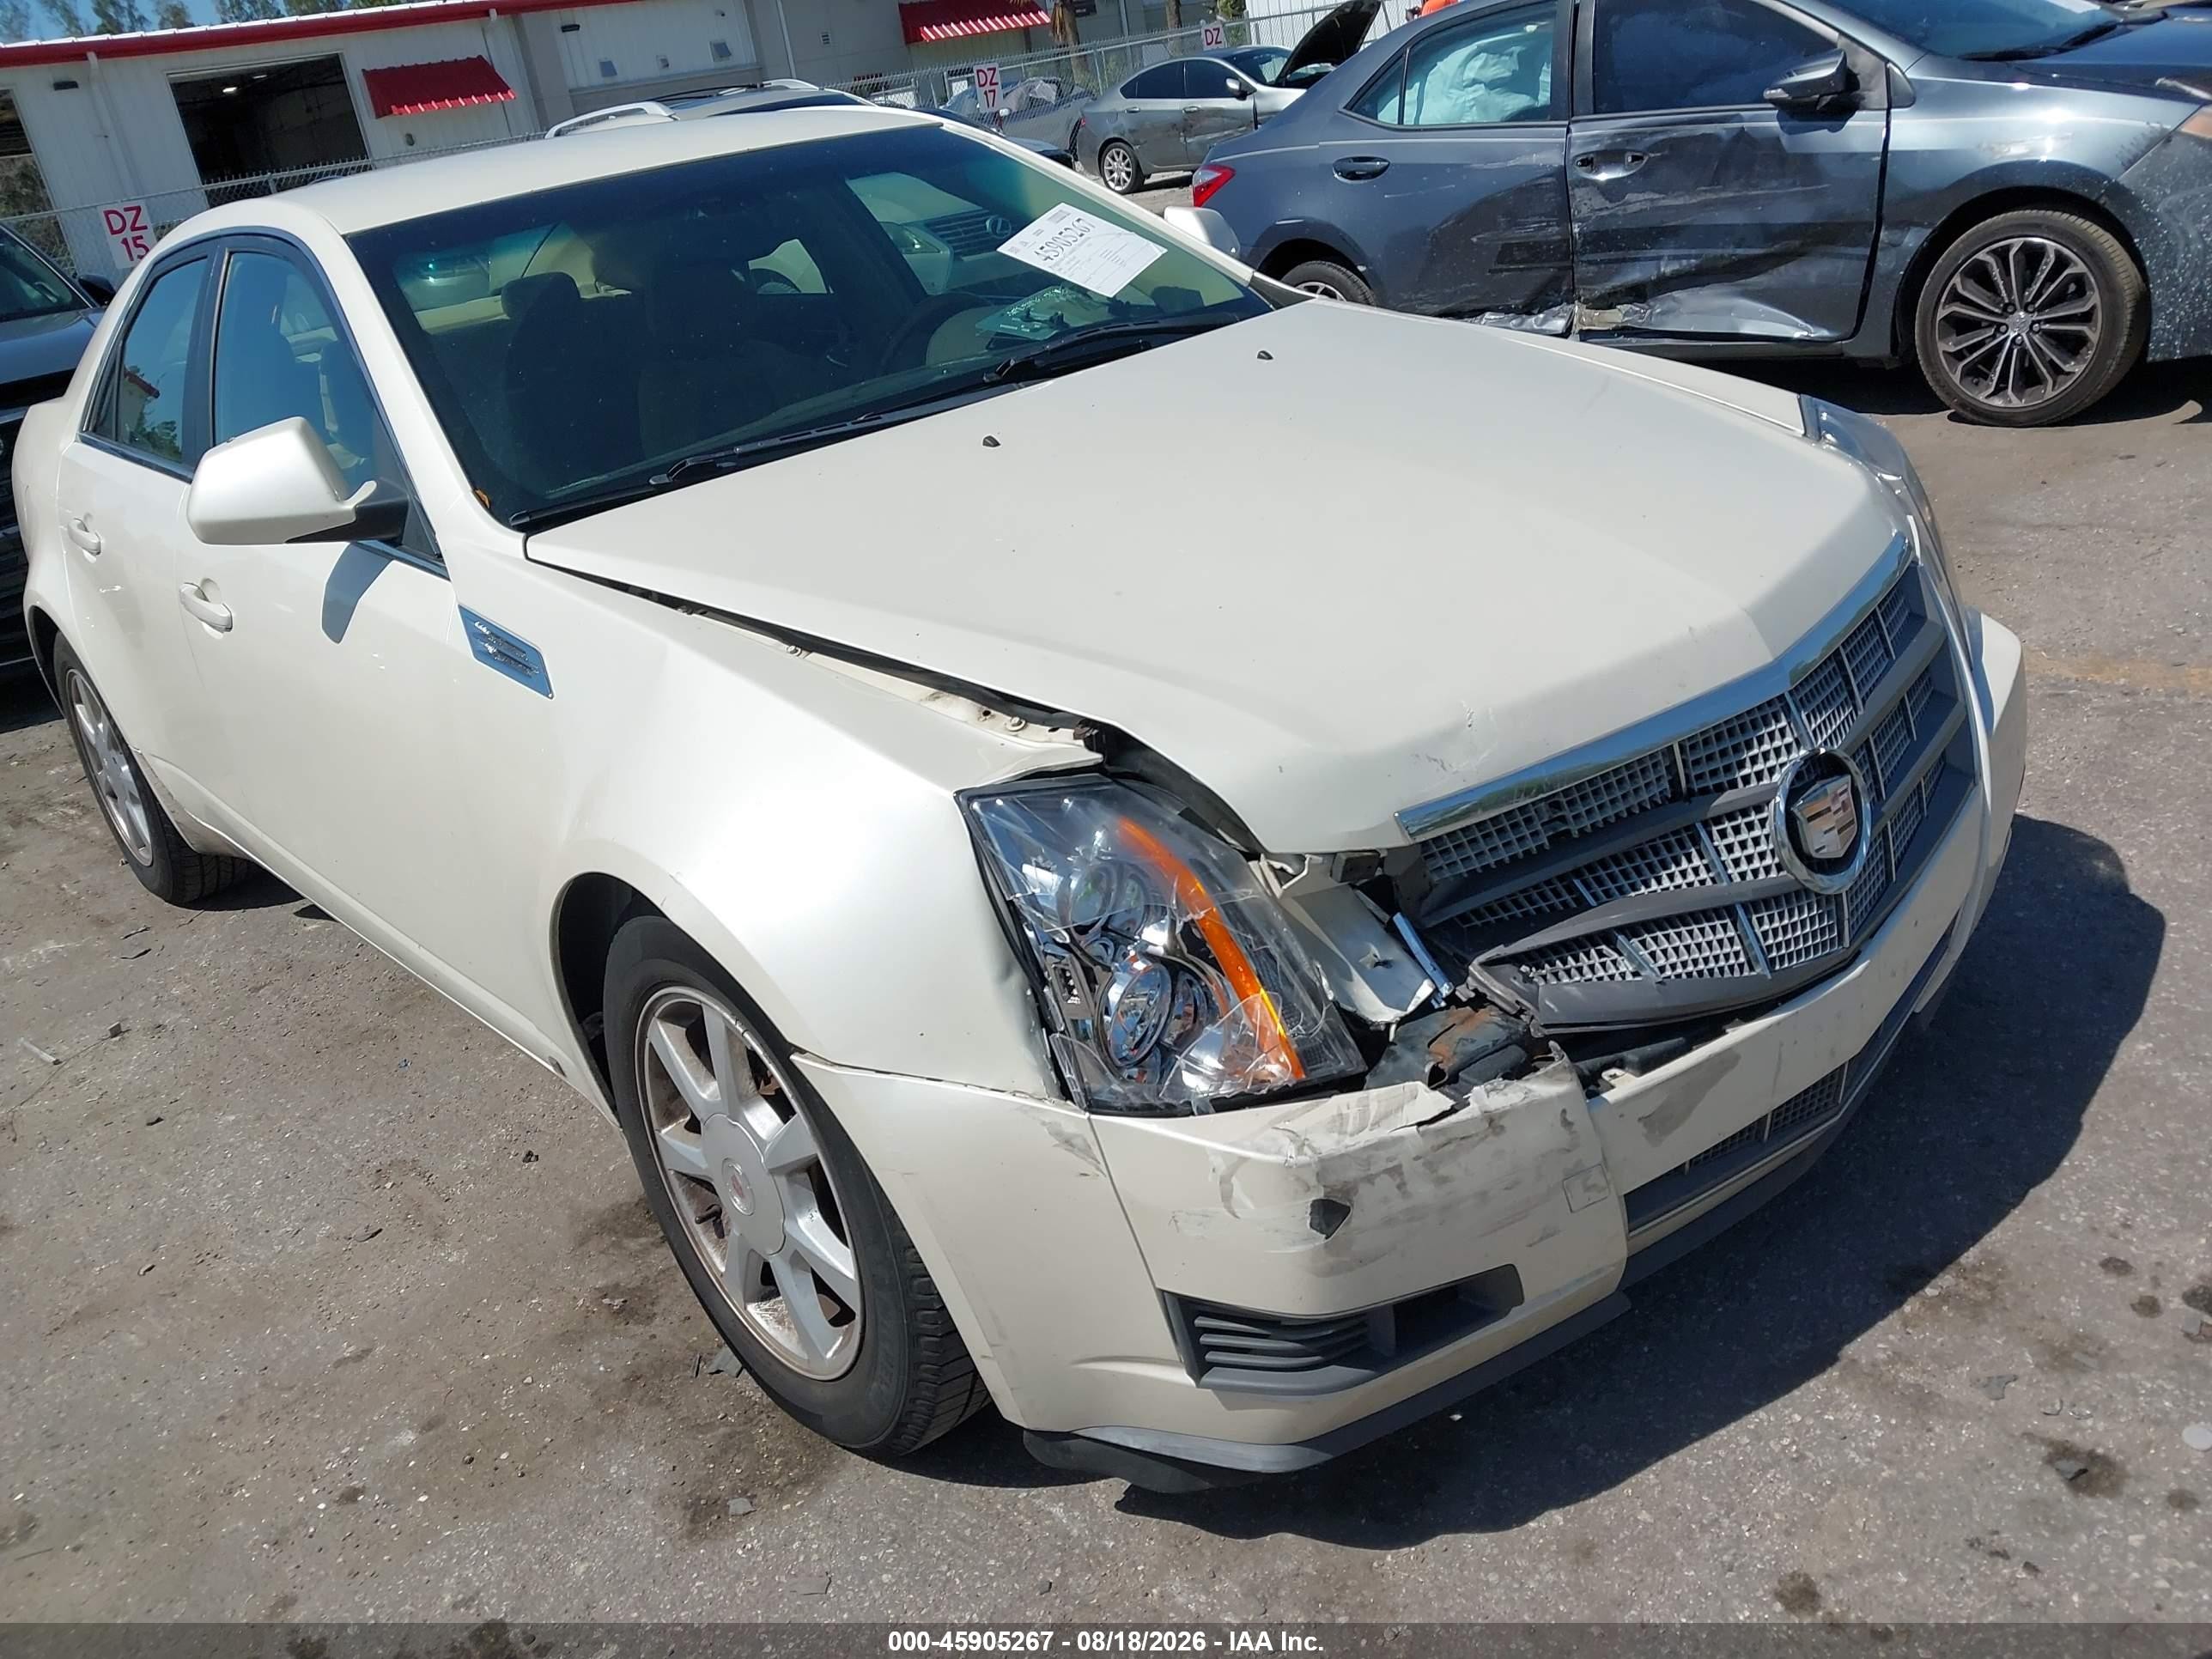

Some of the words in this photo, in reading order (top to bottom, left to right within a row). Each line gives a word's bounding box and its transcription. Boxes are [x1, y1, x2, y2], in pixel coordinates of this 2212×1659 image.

[1205, 27, 1222, 46] DZ
[976, 67, 999, 88] DZ
[984, 89, 996, 108] 17
[103, 205, 148, 235] DZ
[121, 234, 149, 261] 15
[1034, 217, 1097, 261] 45905267
